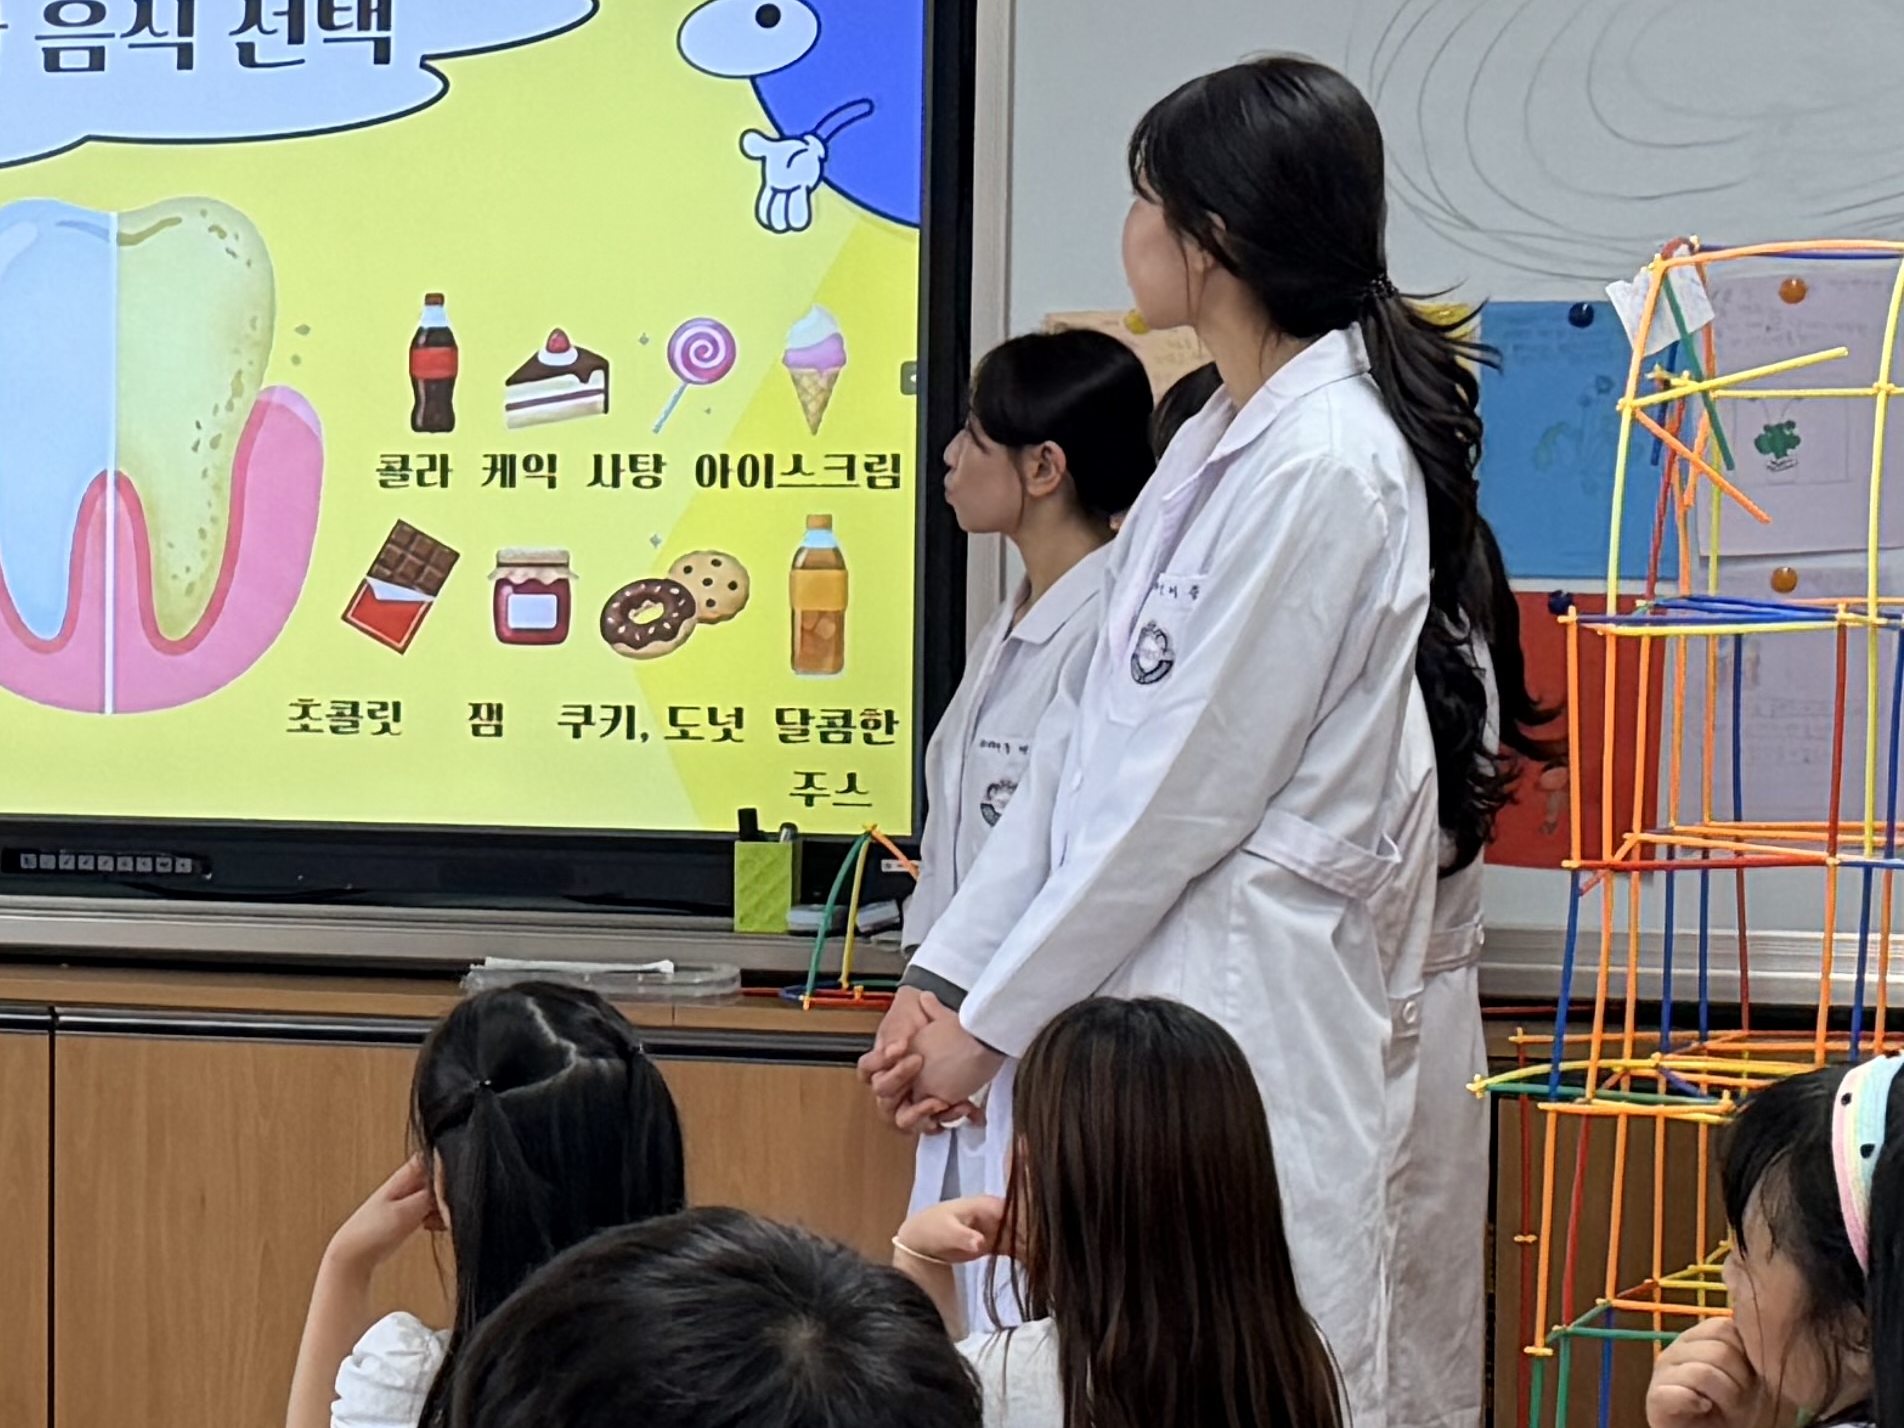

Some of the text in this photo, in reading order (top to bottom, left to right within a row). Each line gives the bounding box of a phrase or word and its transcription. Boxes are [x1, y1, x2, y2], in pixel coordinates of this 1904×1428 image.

[374, 452, 902, 491] 콜라 케익 사탕 아이스크림
[285, 697, 901, 747] 초콜릿 잼 쿠키, 도넛 달콤한
[788, 770, 874, 809] 주스
